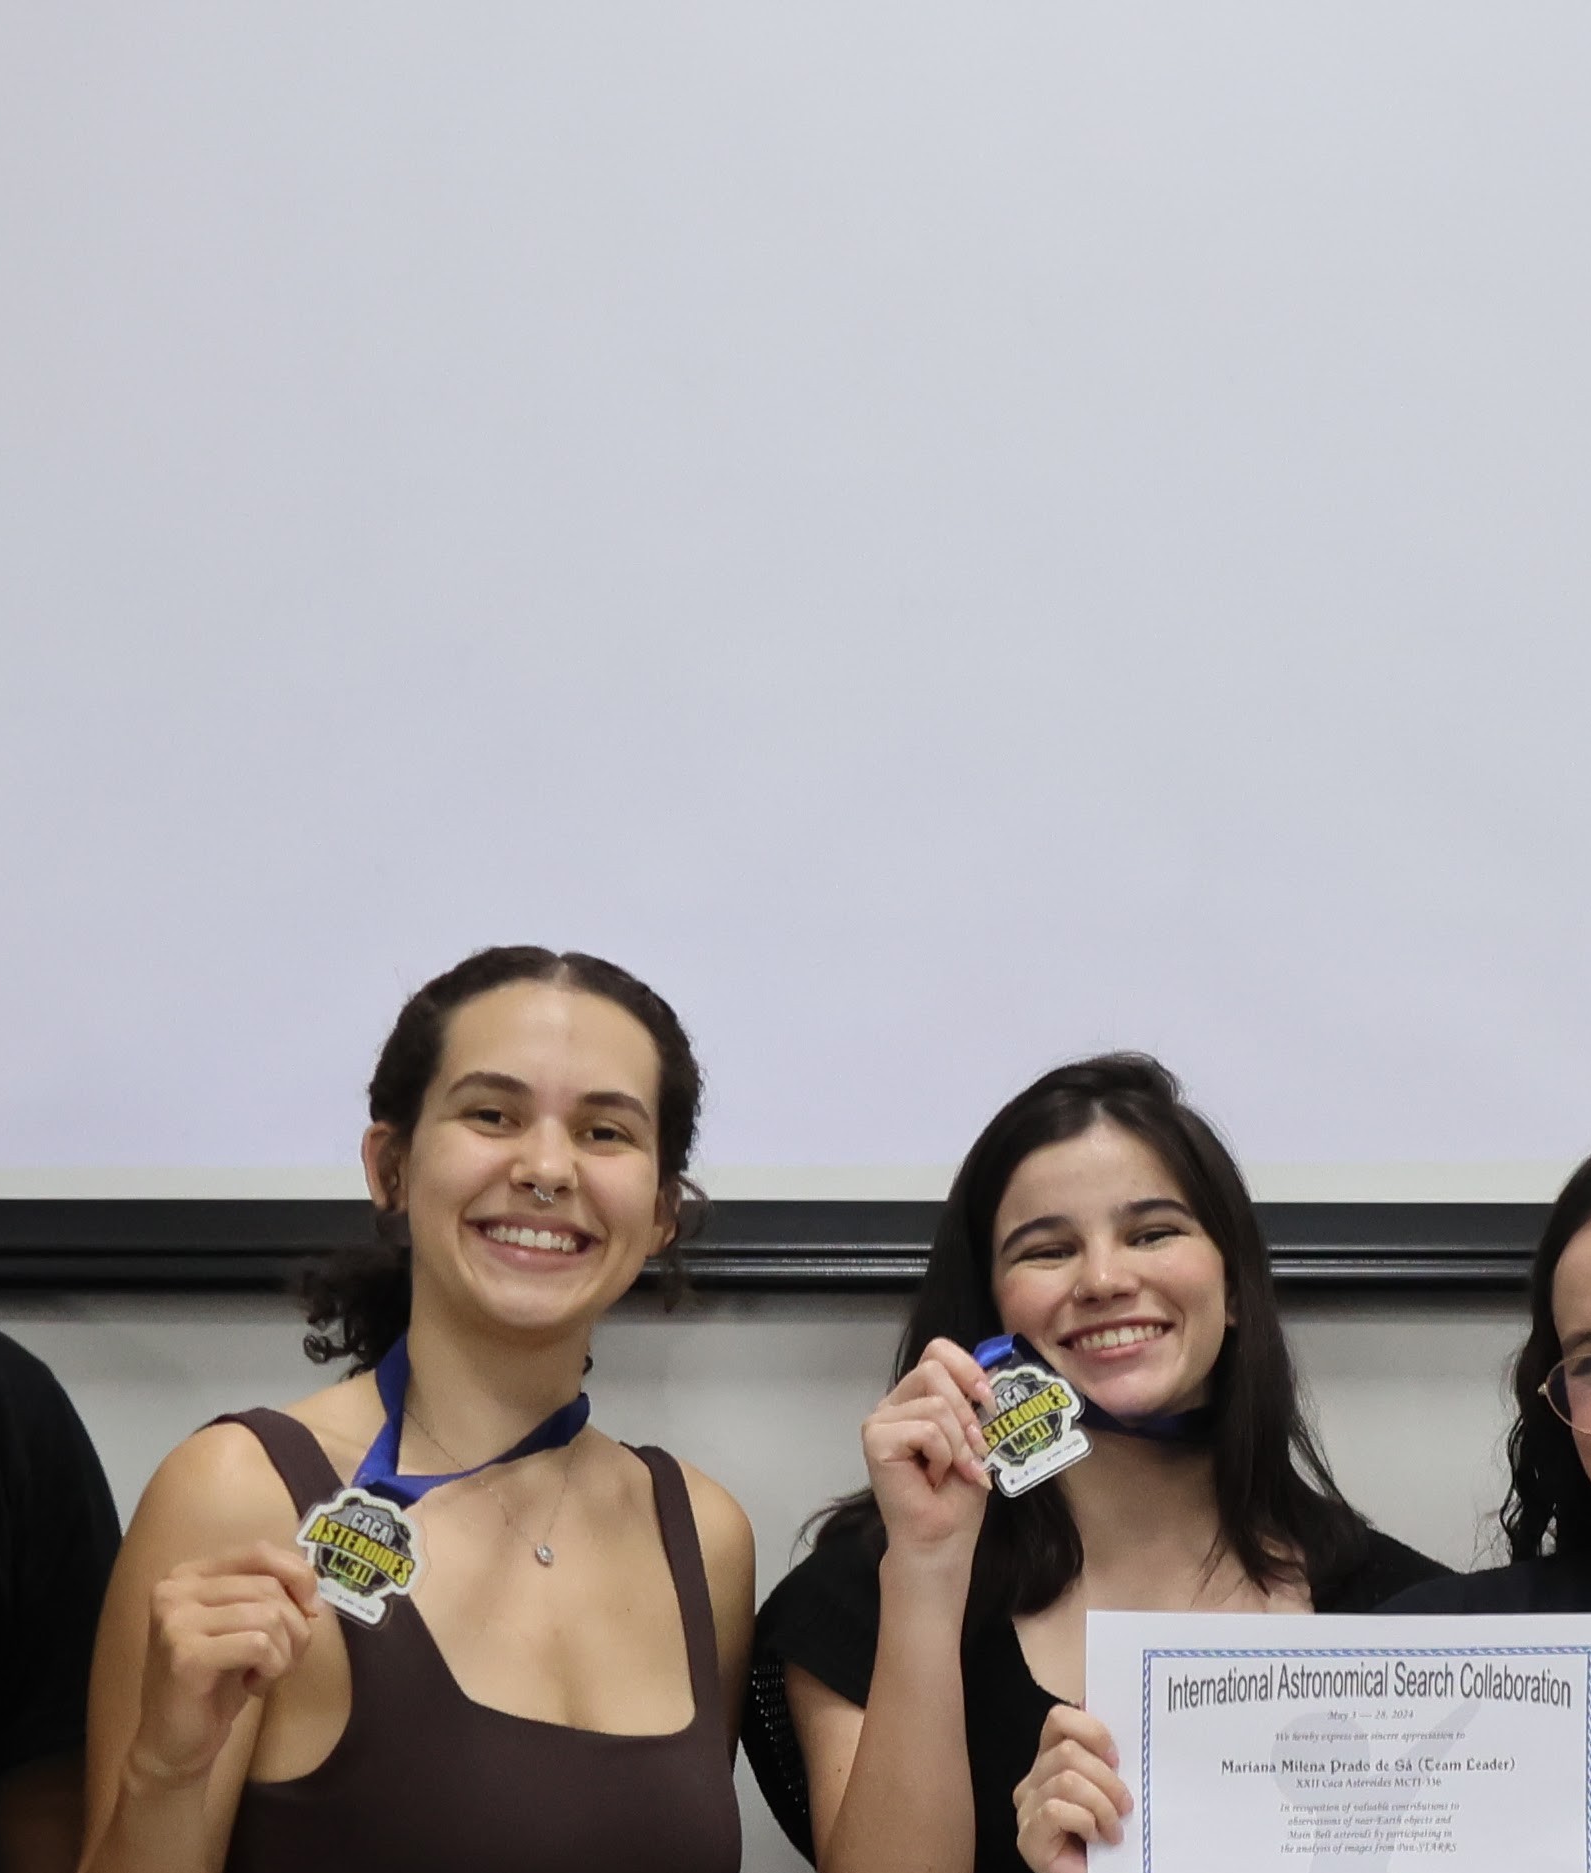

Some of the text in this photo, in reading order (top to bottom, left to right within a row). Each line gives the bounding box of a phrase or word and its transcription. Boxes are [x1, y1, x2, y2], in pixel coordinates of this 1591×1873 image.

[982, 1383, 1072, 1449] STEROIDES
[308, 1514, 415, 1587] ASTEROIDES
[1168, 1661, 1571, 1712] International Astronomical Search Collaboration
[1327, 1710, 1349, 1722] May
[1391, 1709, 1414, 1720] 2024
[1321, 1733, 1351, 1743] express
[1221, 1759, 1276, 1775] Mariana
[1281, 1759, 1326, 1775] Milena
[1330, 1758, 1371, 1775] Prado
[1375, 1758, 1389, 1772] de
[1418, 1758, 1461, 1773] (Team
[1466, 1757, 1516, 1771] Leader)
